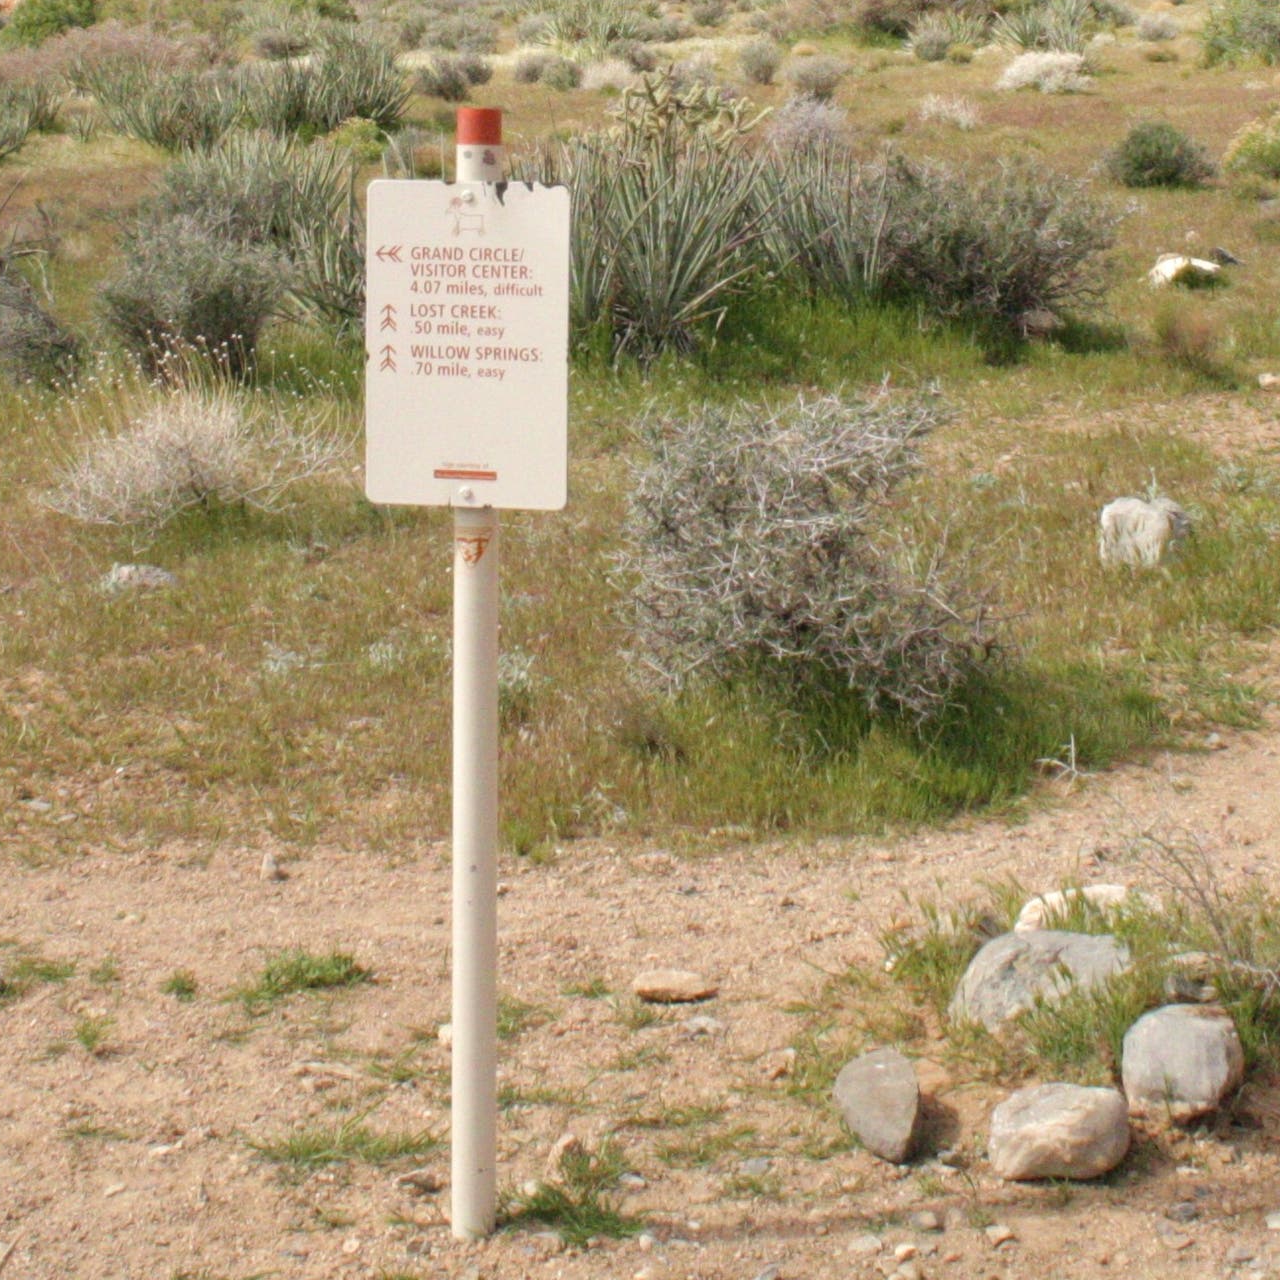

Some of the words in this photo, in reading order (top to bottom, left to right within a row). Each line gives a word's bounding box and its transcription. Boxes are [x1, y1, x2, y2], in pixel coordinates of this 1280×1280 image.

[411, 246, 463, 261] GRAND
[469, 248, 525, 262] CIRCLE/
[411, 263, 466, 277] VISITOR
[472, 265, 533, 279] CENTER:
[410, 281, 441, 294] 4.07
[446, 281, 488, 297] miles,
[494, 283, 543, 297] difficult
[410, 304, 446, 318] LOST
[451, 305, 502, 319] CREEK:
[410, 321, 432, 334] .50
[437, 322, 470, 336] mile,
[477, 326, 505, 340] easy
[411, 345, 470, 359] WILLOW
[475, 347, 543, 362] SPRINGS:
[438, 363, 471, 378] mile,
[477, 367, 506, 381] easy
